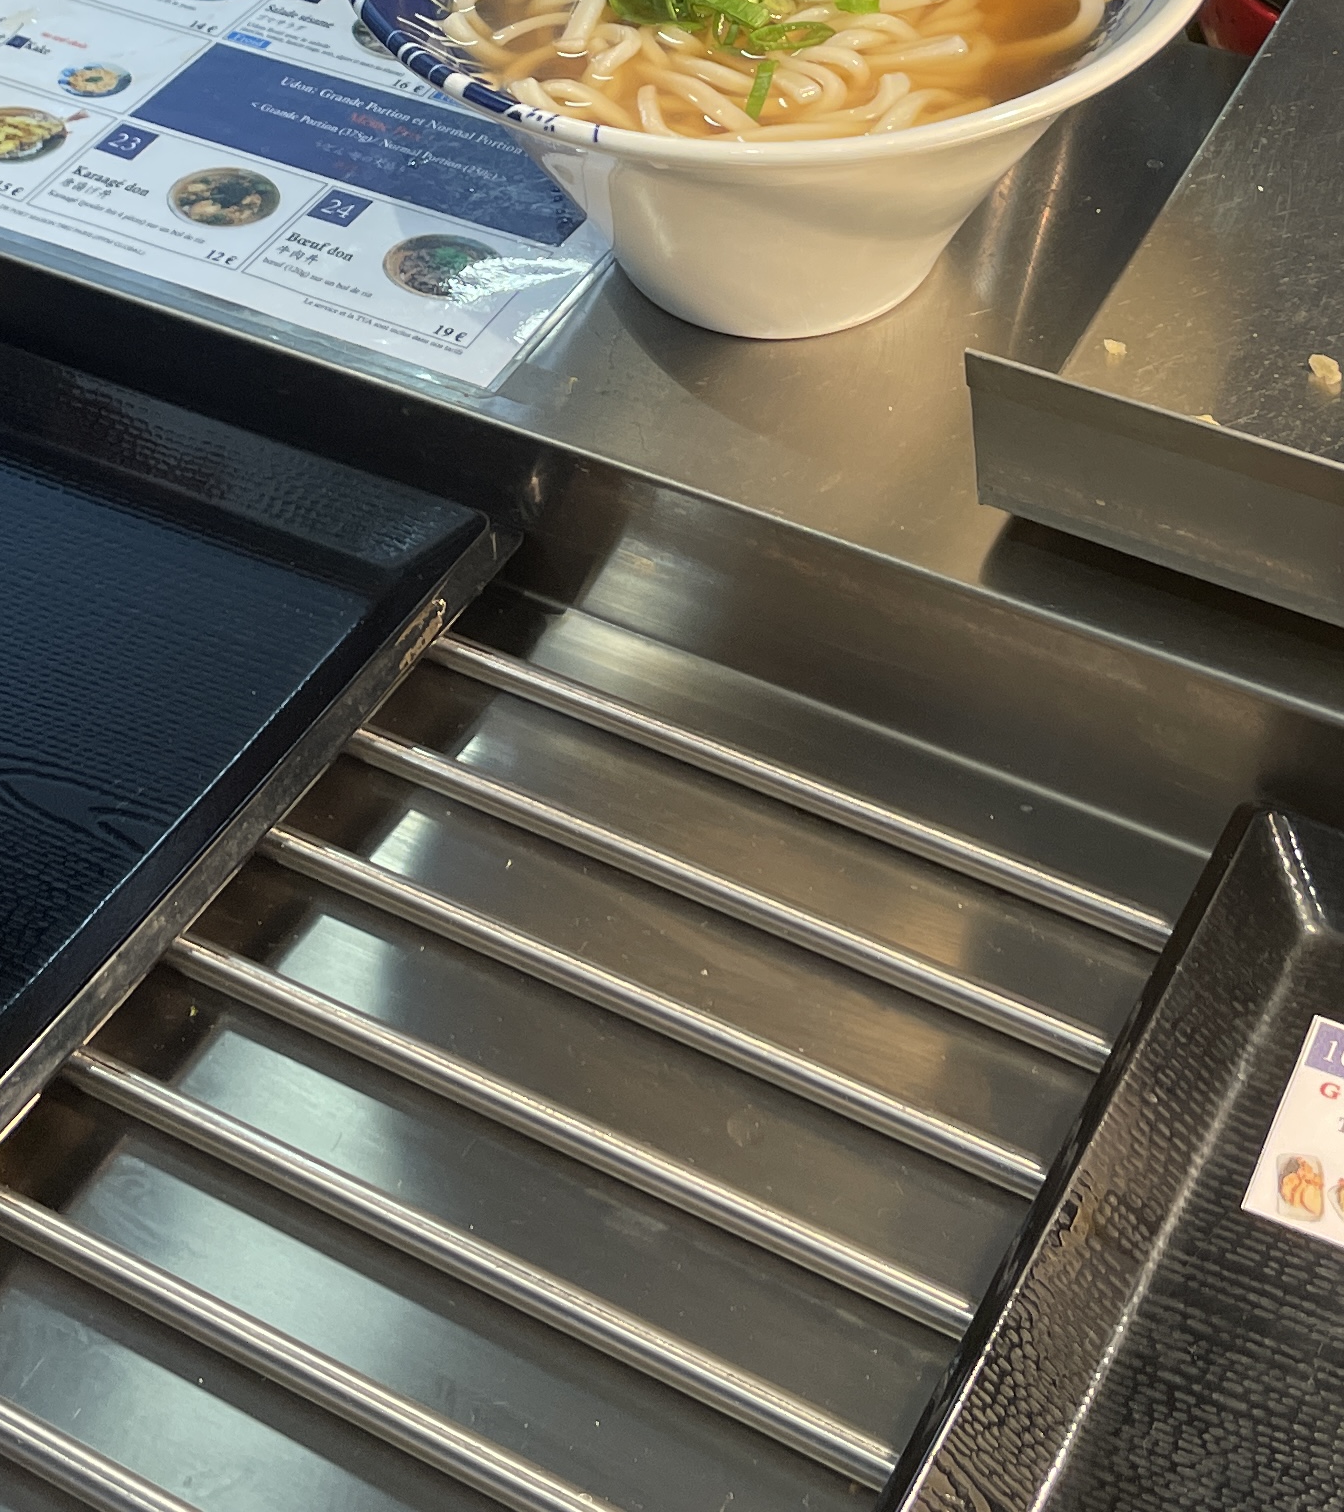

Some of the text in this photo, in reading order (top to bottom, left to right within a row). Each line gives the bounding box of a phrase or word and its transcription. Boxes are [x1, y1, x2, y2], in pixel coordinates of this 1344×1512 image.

[393, 79, 408, 89] 16
[281, 76, 523, 155] Udon: Grande Portion et Normal Portion
[108, 133, 141, 151] 23
[260, 104, 299, 120] Grande
[299, 115, 339, 133] Portion
[384, 138, 423, 157] Normal
[421, 151, 462, 169] Portion
[72, 165, 150, 197] Karaagé don
[11, 187, 24, 196] €
[321, 199, 355, 219] 24
[277, 245, 319, 266] 牛肉丼
[286, 232, 354, 262] Bœuf don
[206, 250, 238, 265] 12 €
[434, 325, 468, 342] 19 €
[1319, 1082, 1341, 1100] G
